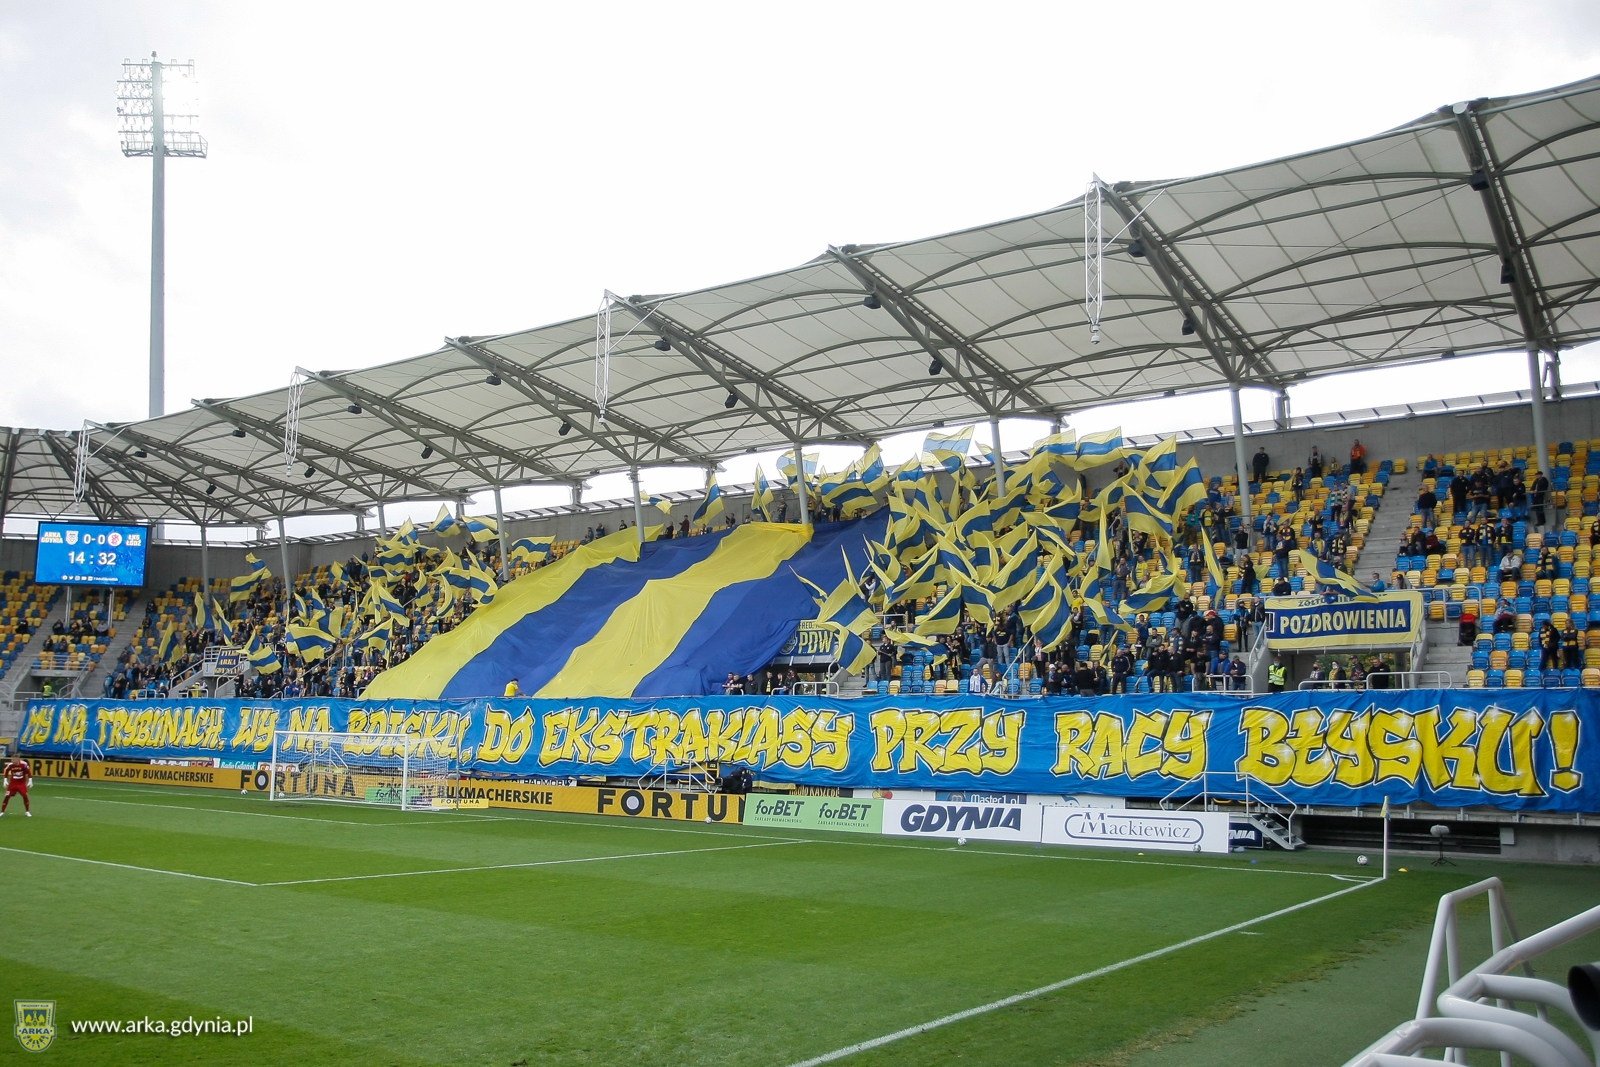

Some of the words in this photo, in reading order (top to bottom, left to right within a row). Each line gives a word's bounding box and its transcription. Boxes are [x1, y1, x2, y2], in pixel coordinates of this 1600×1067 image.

[1279, 608, 1407, 635] POZDROWIENIA
[797, 631, 833, 654] PDW
[20, 704, 57, 747] MY
[53, 704, 88, 745] NA
[230, 707, 281, 753] WY
[281, 706, 335, 755] NA
[475, 703, 536, 765] DO
[537, 706, 856, 771] EKSTRAKLASY
[869, 708, 1027, 777] PRZY
[1049, 709, 1215, 781] RACY
[104, 767, 141, 780] ZAKŁADY
[142, 769, 214, 784] BUKMACHERSKIE
[755, 799, 805, 816] forBET
[818, 802, 872, 820] forBET
[900, 804, 1022, 832] GDYNIA
[1079, 811, 1192, 838] Mackiewicz
